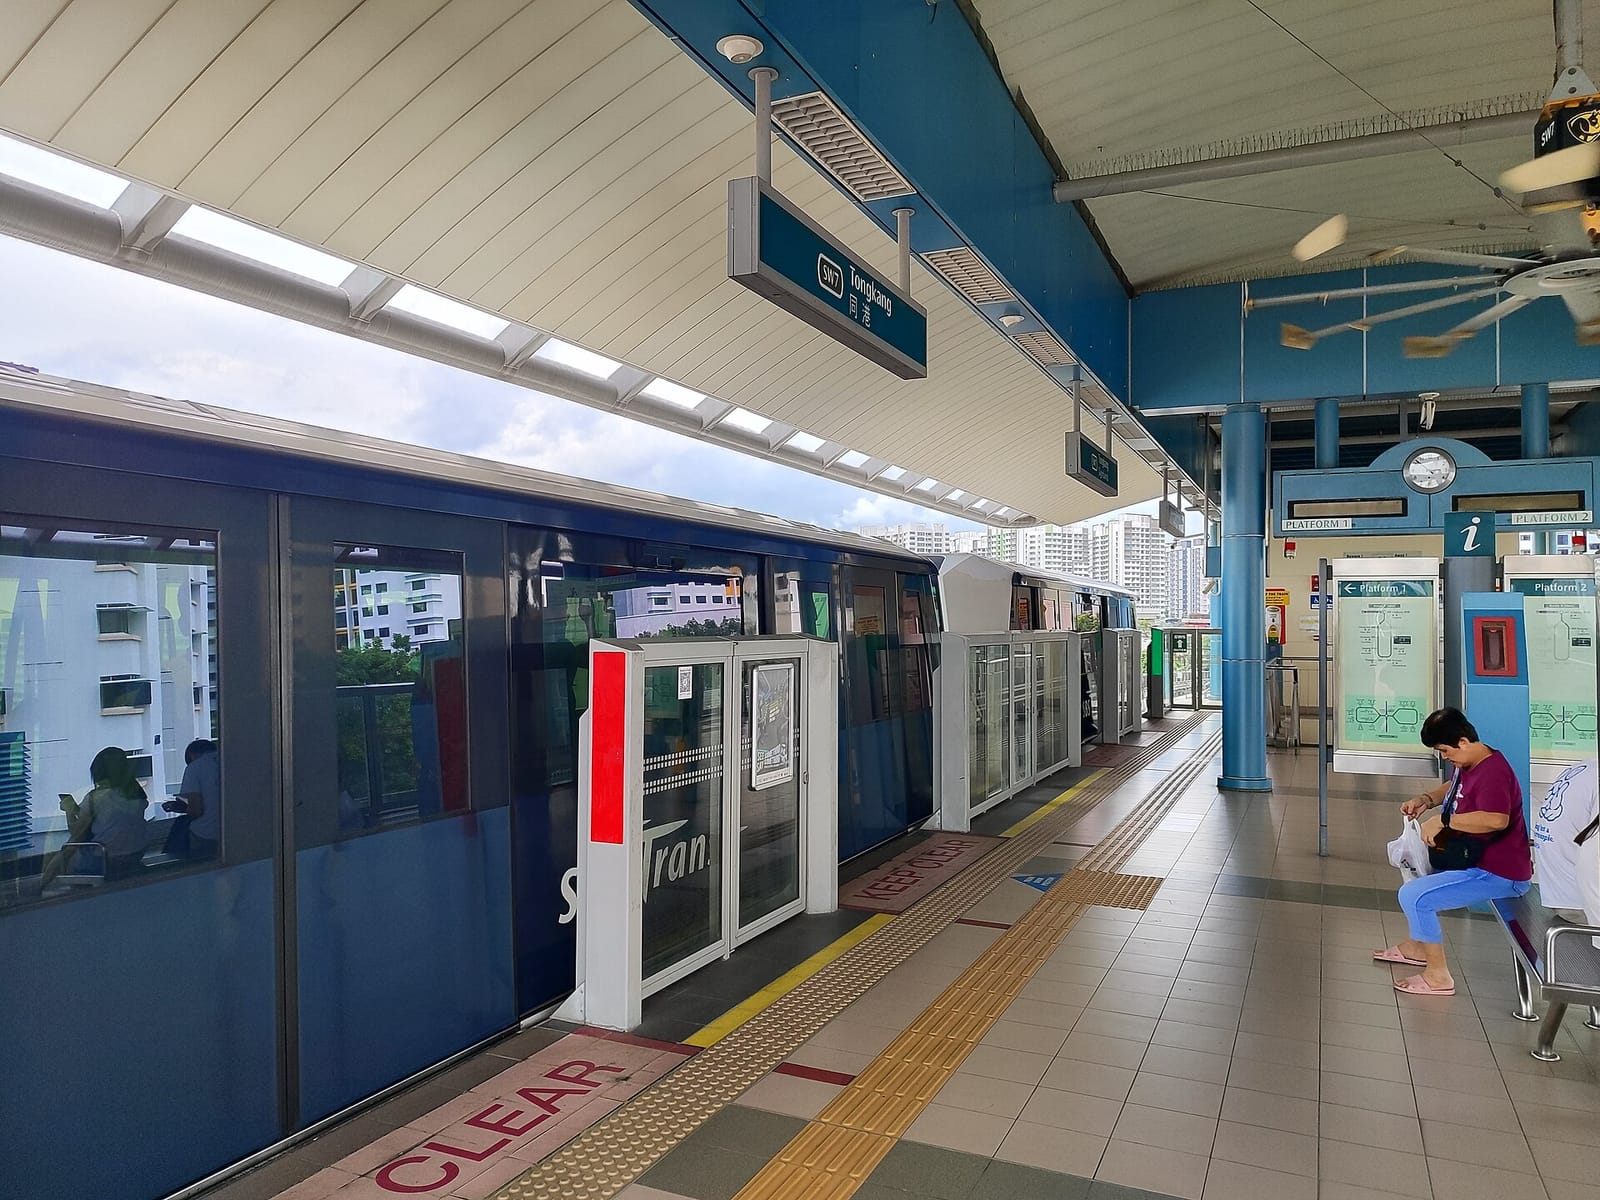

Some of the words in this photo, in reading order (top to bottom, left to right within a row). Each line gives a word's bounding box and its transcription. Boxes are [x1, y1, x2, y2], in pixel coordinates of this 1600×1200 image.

[1541, 121, 1555, 146] SW7
[823, 264, 839, 288] SW7
[849, 264, 892, 317] Tongkang
[849, 293, 871, 328] 同港
[1285, 519, 1339, 529] PLATFORM
[1343, 519, 1348, 527] 1
[1516, 513, 1578, 523] PLATFORM
[1582, 512, 1589, 521] 2
[1360, 583, 1399, 593] Platform
[1535, 583, 1578, 592] Platform
[1580, 583, 1588, 592] 2
[853, 869, 926, 900] KEEP
[905, 839, 981, 870] CLEAR
[375, 1059, 626, 1193] CLEAR
